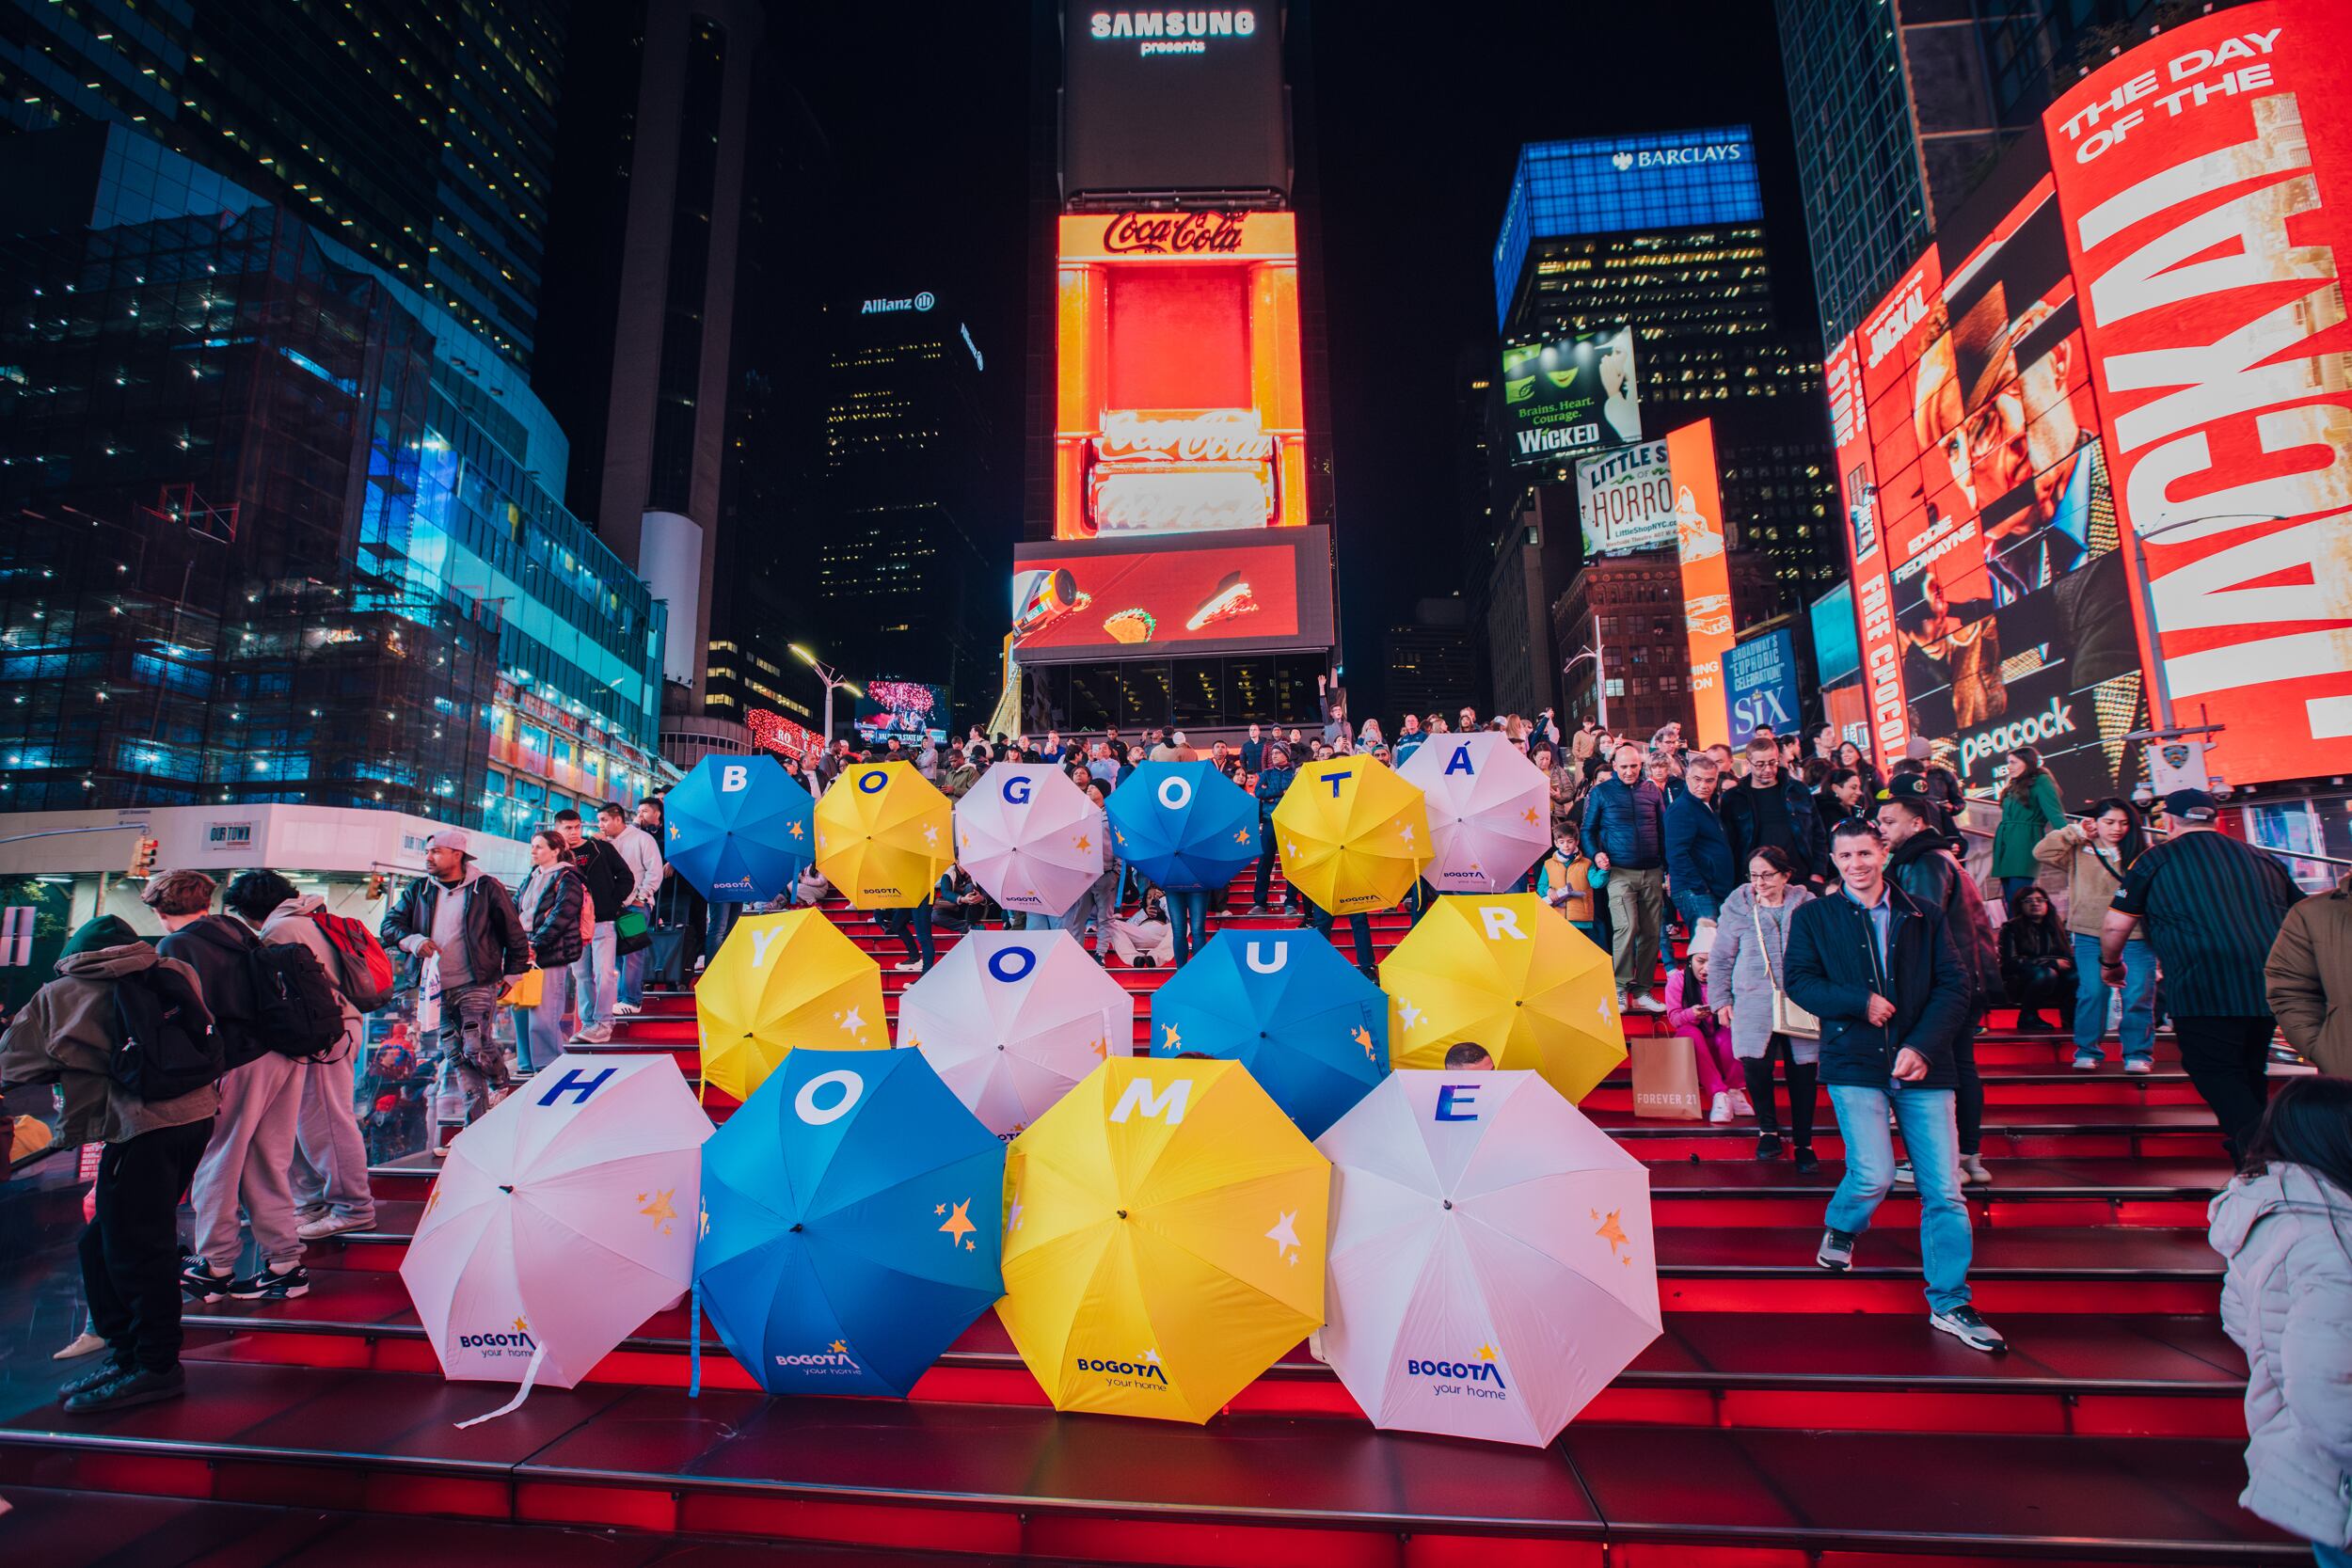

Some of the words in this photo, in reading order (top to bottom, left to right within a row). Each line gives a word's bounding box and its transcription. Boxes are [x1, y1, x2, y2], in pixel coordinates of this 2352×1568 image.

[1091, 10, 1255, 38] SAMSUNG
[1141, 40, 1205, 56] presents
[2058, 69, 2159, 141] THE
[2168, 27, 2282, 82] DAY
[2076, 108, 2145, 164] OF
[2154, 63, 2275, 118] THE
[1638, 144, 1740, 167] BARCLAYS
[861, 297, 913, 314] Allianz
[1518, 403, 1558, 418] Brains.
[1560, 396, 1595, 411] Heart.
[1533, 410, 1581, 425] Courage.
[1591, 447, 1651, 489] LITTLE
[1636, 469, 1649, 480] OF
[1907, 515, 1953, 556] EDDIE
[1893, 520, 1977, 585] REDMAYNE
[1861, 574, 1891, 642] FREE
[1732, 634, 1777, 662] BROADWAY'S
[902, 733, 916, 741] STATE
[1960, 696, 2077, 777] peacock
[722, 766, 748, 793] B
[858, 770, 887, 794] O
[1002, 776, 1032, 804] G
[1158, 776, 1191, 810] O
[1321, 771, 1352, 798] T
[1444, 740, 1474, 775] Á
[227, 826, 250, 841] TOWN
[752, 926, 784, 968] Y
[988, 946, 1036, 983] O
[1247, 942, 1288, 974] U
[1478, 907, 1528, 940] R
[537, 1068, 618, 1106] H
[794, 1069, 864, 1126] O
[1109, 1078, 1193, 1125] M
[1435, 1085, 1481, 1121] E
[1637, 1093, 1681, 1104] FOREVER
[1685, 1094, 1697, 1104] 21
[482, 1348, 502, 1358] your
[803, 1367, 827, 1376] your
[829, 1367, 863, 1375] home
[1105, 1378, 1133, 1390] your
[1134, 1379, 1168, 1391] home
[1433, 1383, 1462, 1398] your
[1467, 1386, 1506, 1401] home
